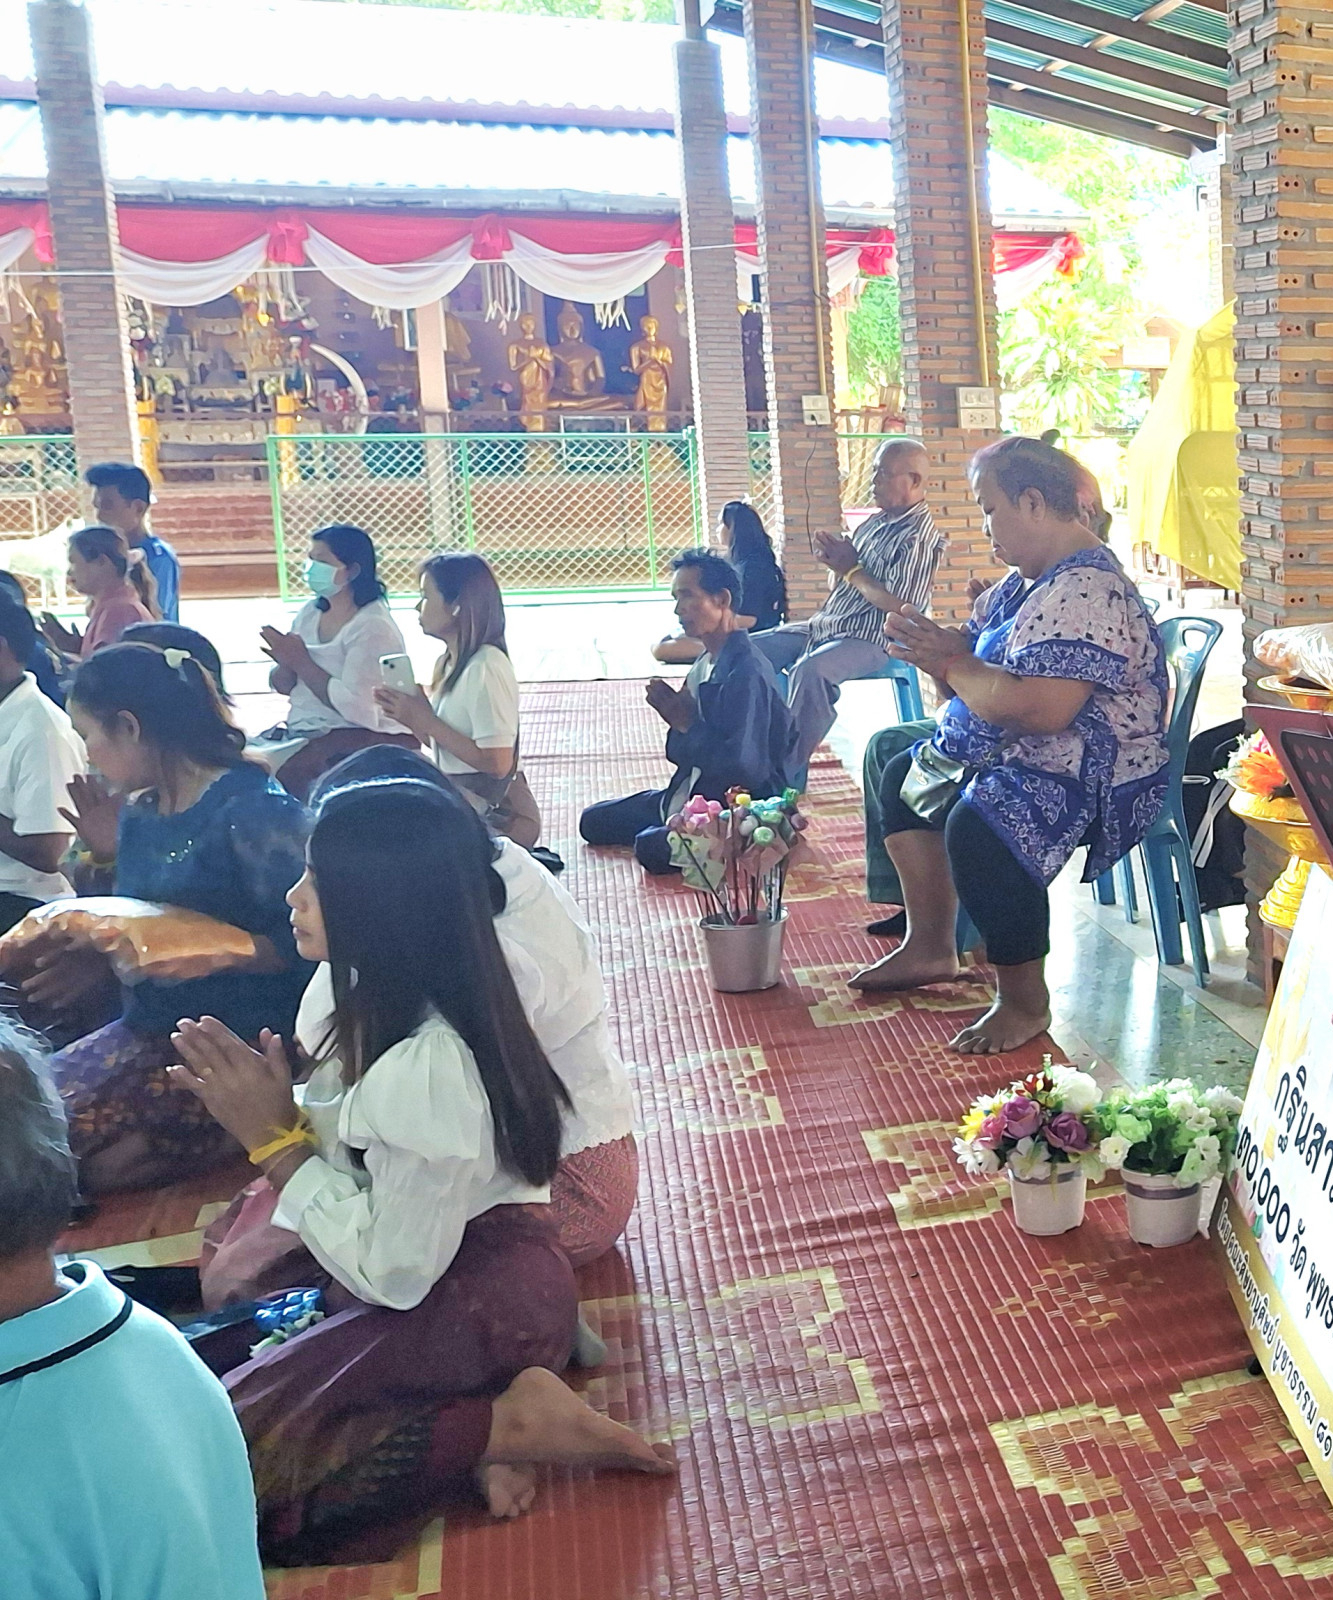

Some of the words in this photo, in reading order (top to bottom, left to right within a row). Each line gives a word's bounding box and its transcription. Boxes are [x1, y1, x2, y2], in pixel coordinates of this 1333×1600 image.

[1237, 1126, 1290, 1243] ๓๐,๐๐๐
[1289, 1218, 1307, 1280] วัด
[1272, 1338, 1318, 1426] บูชาธรรม
